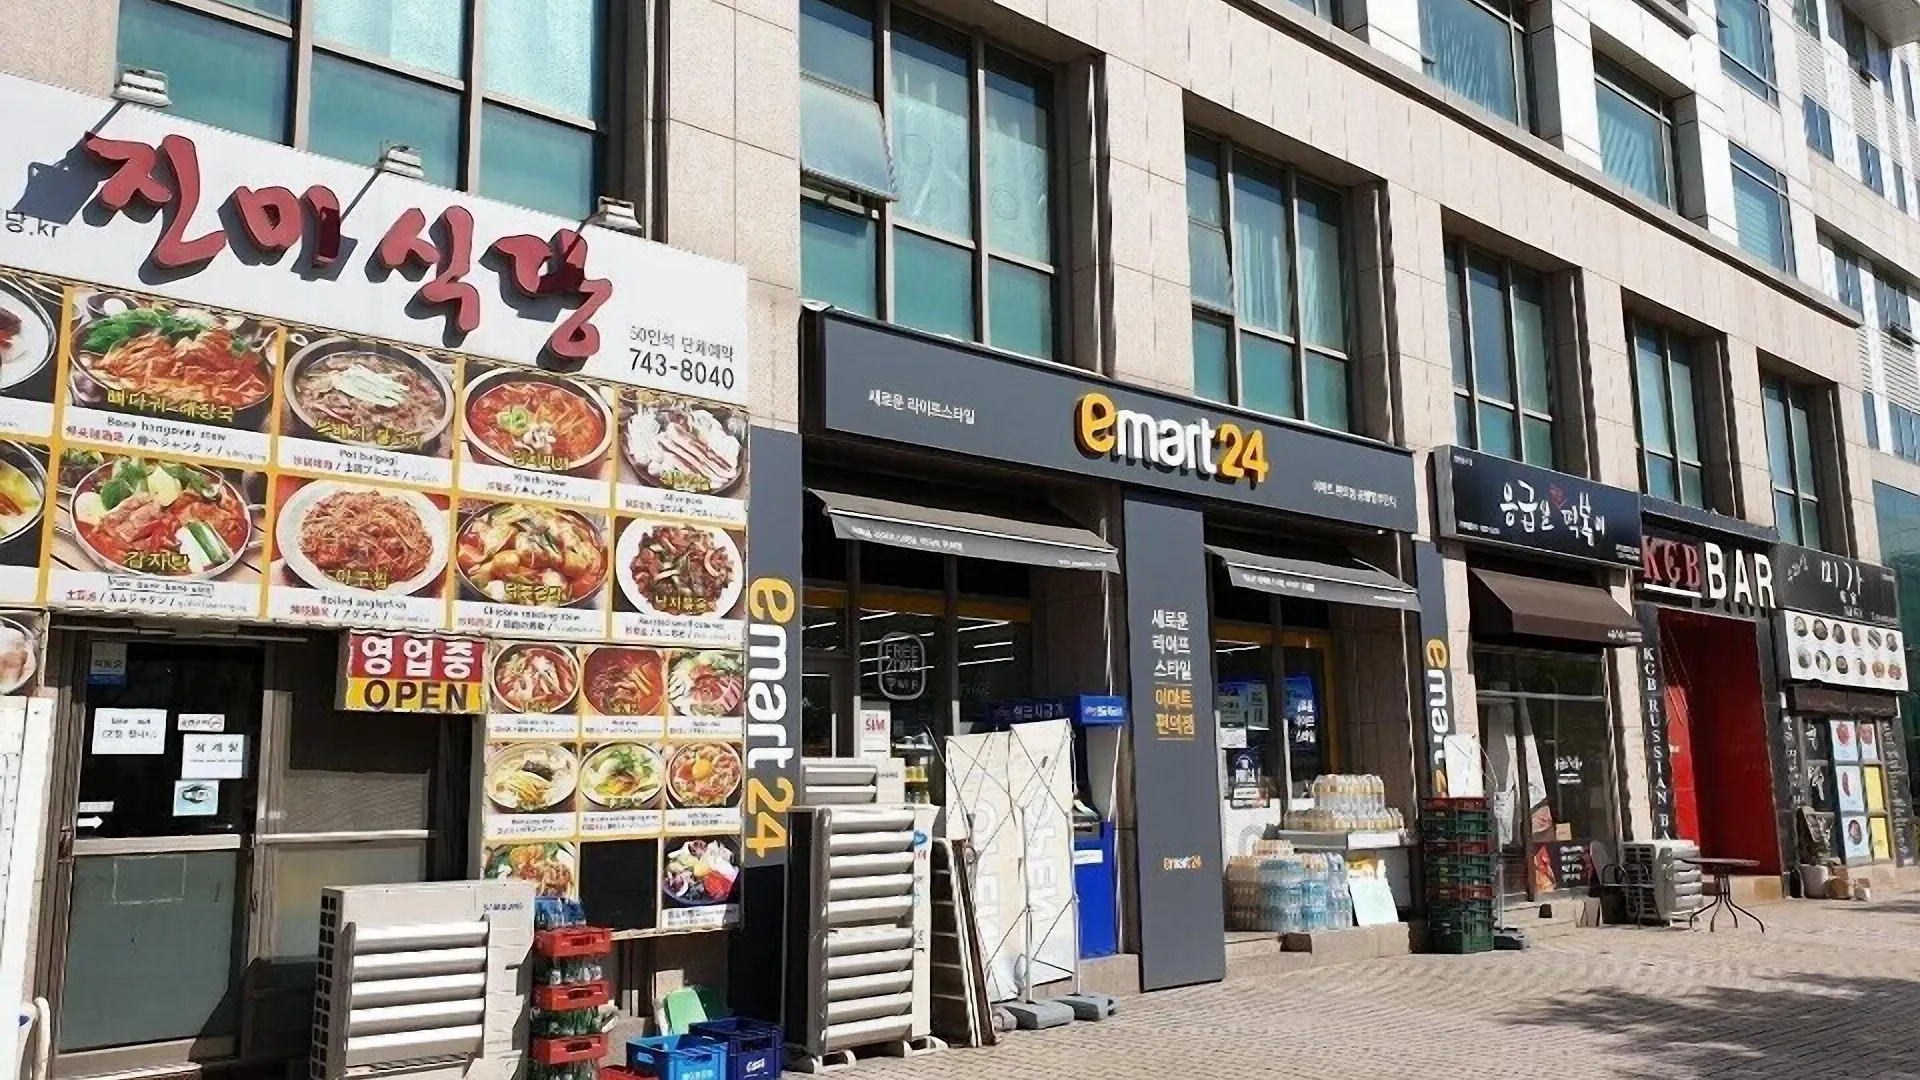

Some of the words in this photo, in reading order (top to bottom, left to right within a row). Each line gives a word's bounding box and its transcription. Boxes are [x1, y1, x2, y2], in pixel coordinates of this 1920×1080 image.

[629, 347, 734, 390] 743-8040
[868, 388, 904, 411] 새로운
[907, 397, 975, 425] 라이프스타일
[1076, 392, 1270, 484] emart24
[1704, 541, 1776, 609] BAR
[1152, 609, 1189, 631] 새로운
[361, 636, 475, 680] 영업중
[1152, 633, 1190, 655] 라이프
[1154, 659, 1192, 681] 스타일
[1643, 647, 1657, 691] KGB
[363, 680, 468, 711] OPEN
[1155, 687, 1193, 710] 이마트
[746, 577, 796, 859] emart24
[1649, 699, 1667, 804] RUSSIAN
